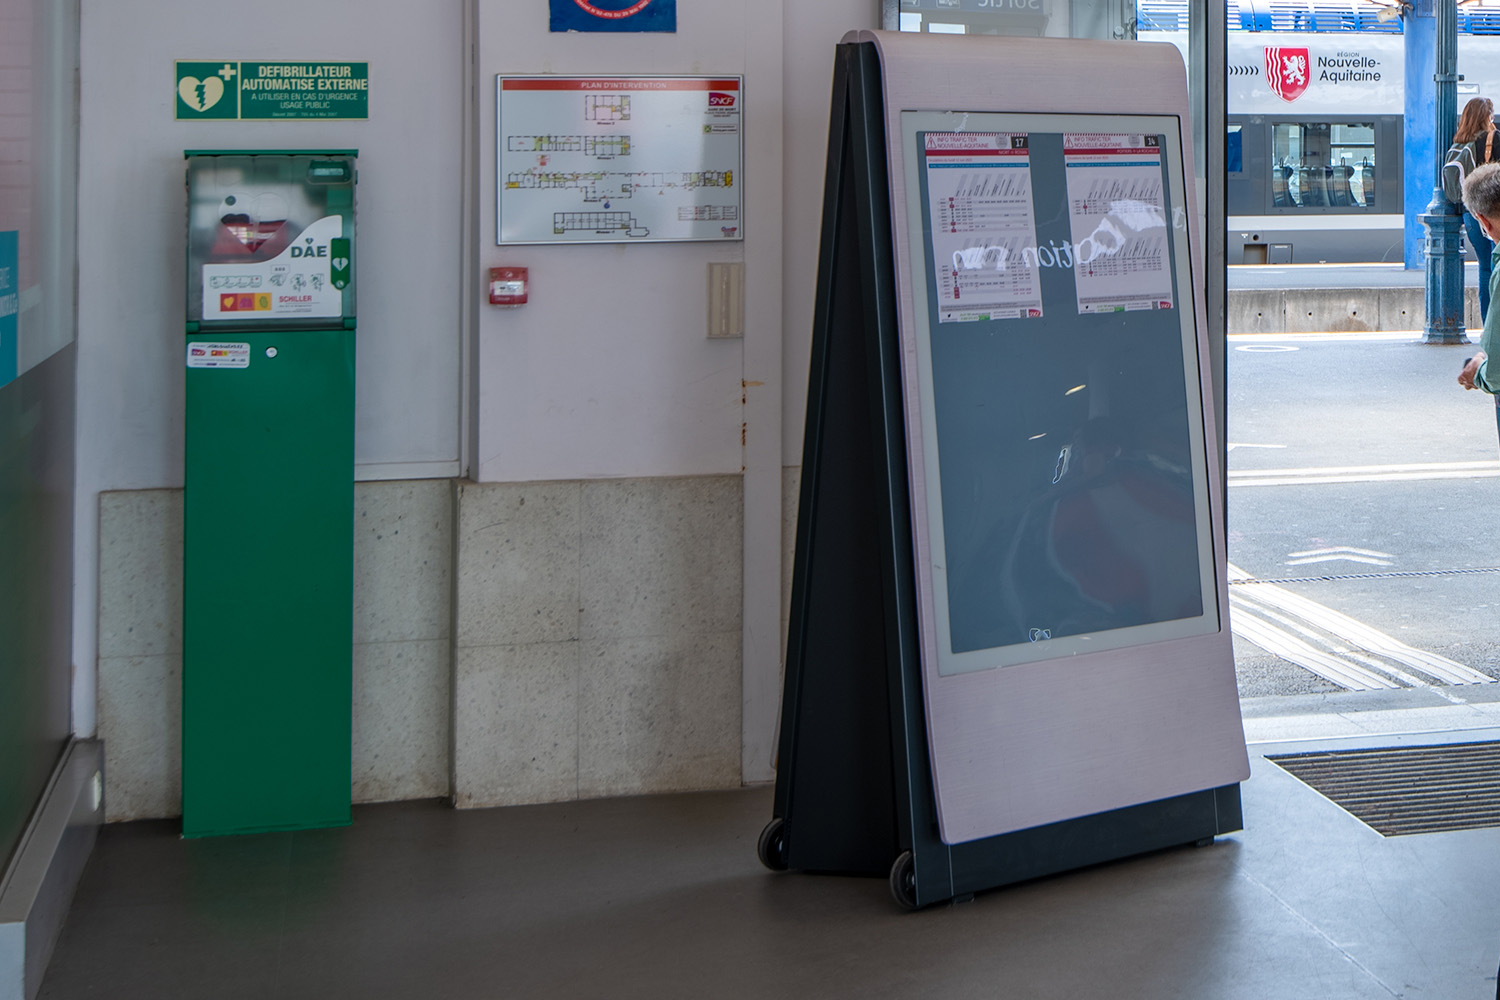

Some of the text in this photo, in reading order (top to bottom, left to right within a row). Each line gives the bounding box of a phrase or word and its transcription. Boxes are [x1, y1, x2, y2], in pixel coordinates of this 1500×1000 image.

[1318, 57, 1381, 68] Nouvelle-
[259, 66, 351, 77] DEFIBRILLATEUR
[1320, 70, 1381, 84] Aquitaine
[242, 79, 368, 90] AUTOMATISE EXTERNE
[1015, 138, 1024, 147] 17
[291, 246, 327, 258] DAE
